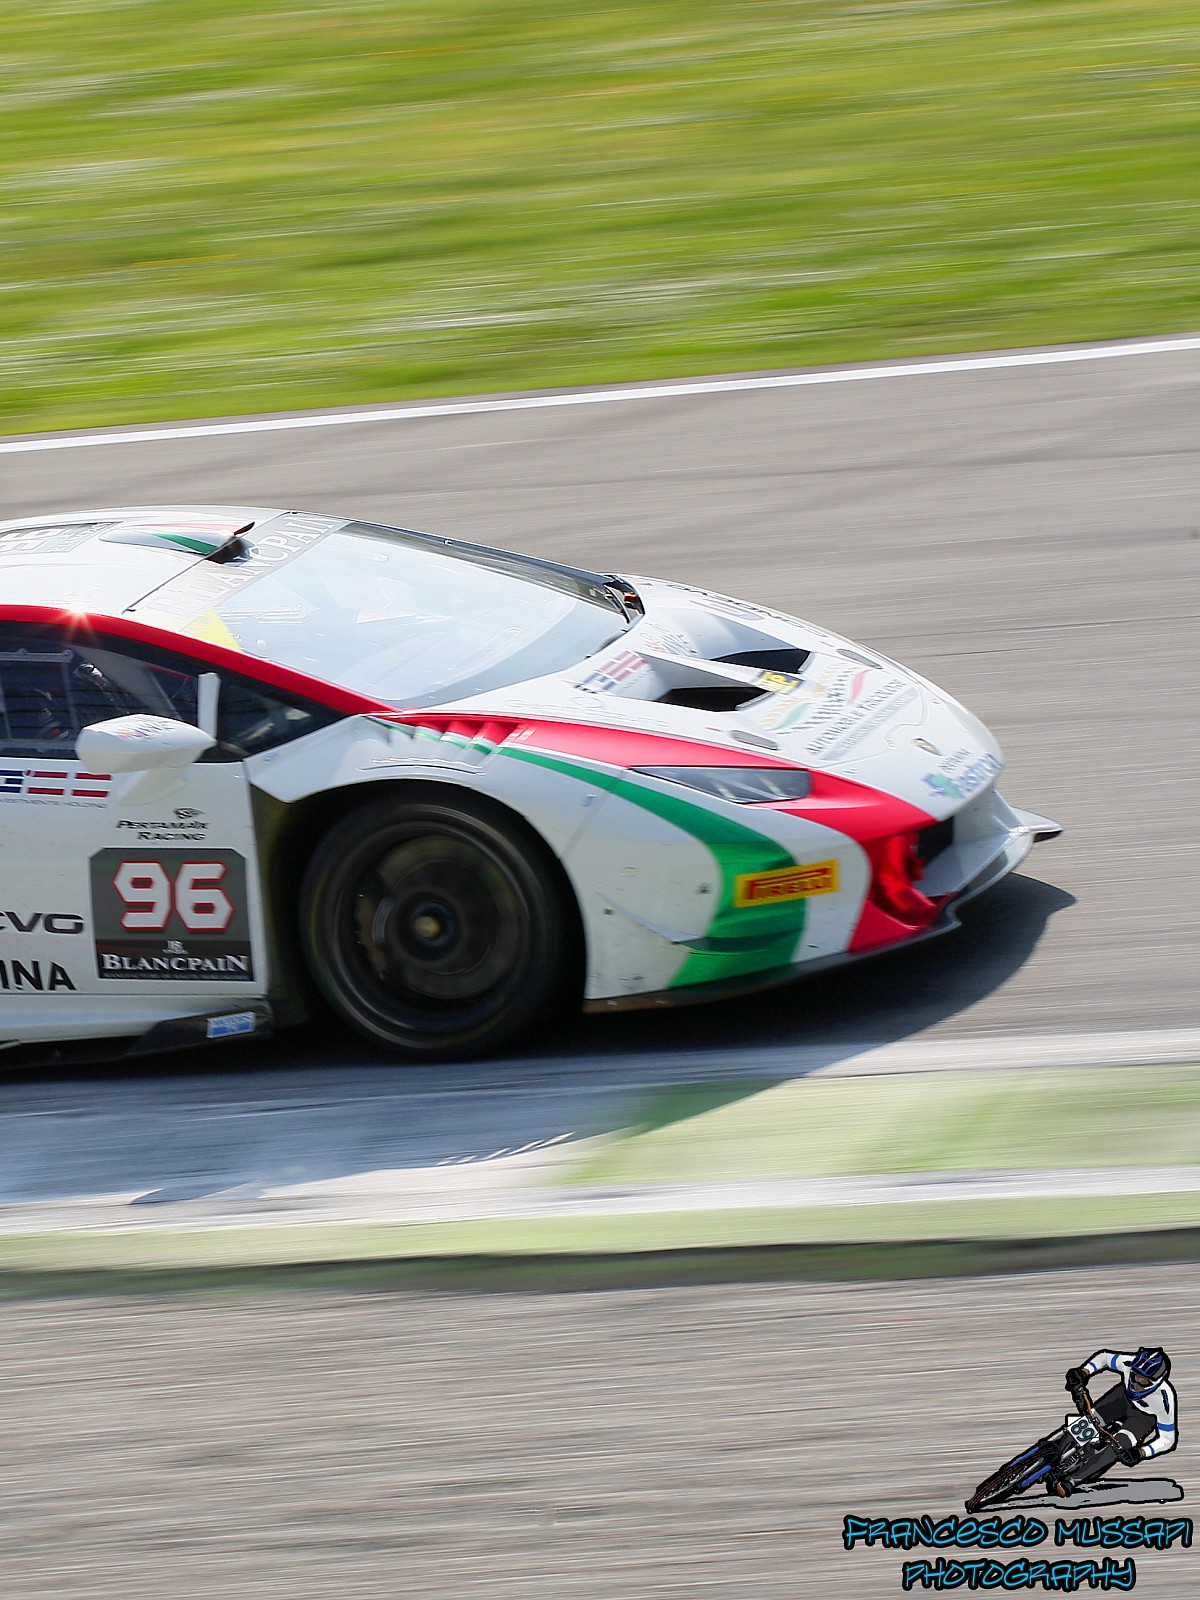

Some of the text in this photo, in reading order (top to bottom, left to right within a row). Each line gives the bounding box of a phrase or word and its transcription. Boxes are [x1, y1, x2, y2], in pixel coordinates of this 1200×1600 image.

[150, 515, 342, 612] LANCPAIN
[113, 860, 235, 932] 96
[101, 953, 249, 972] BLANCPAIN
